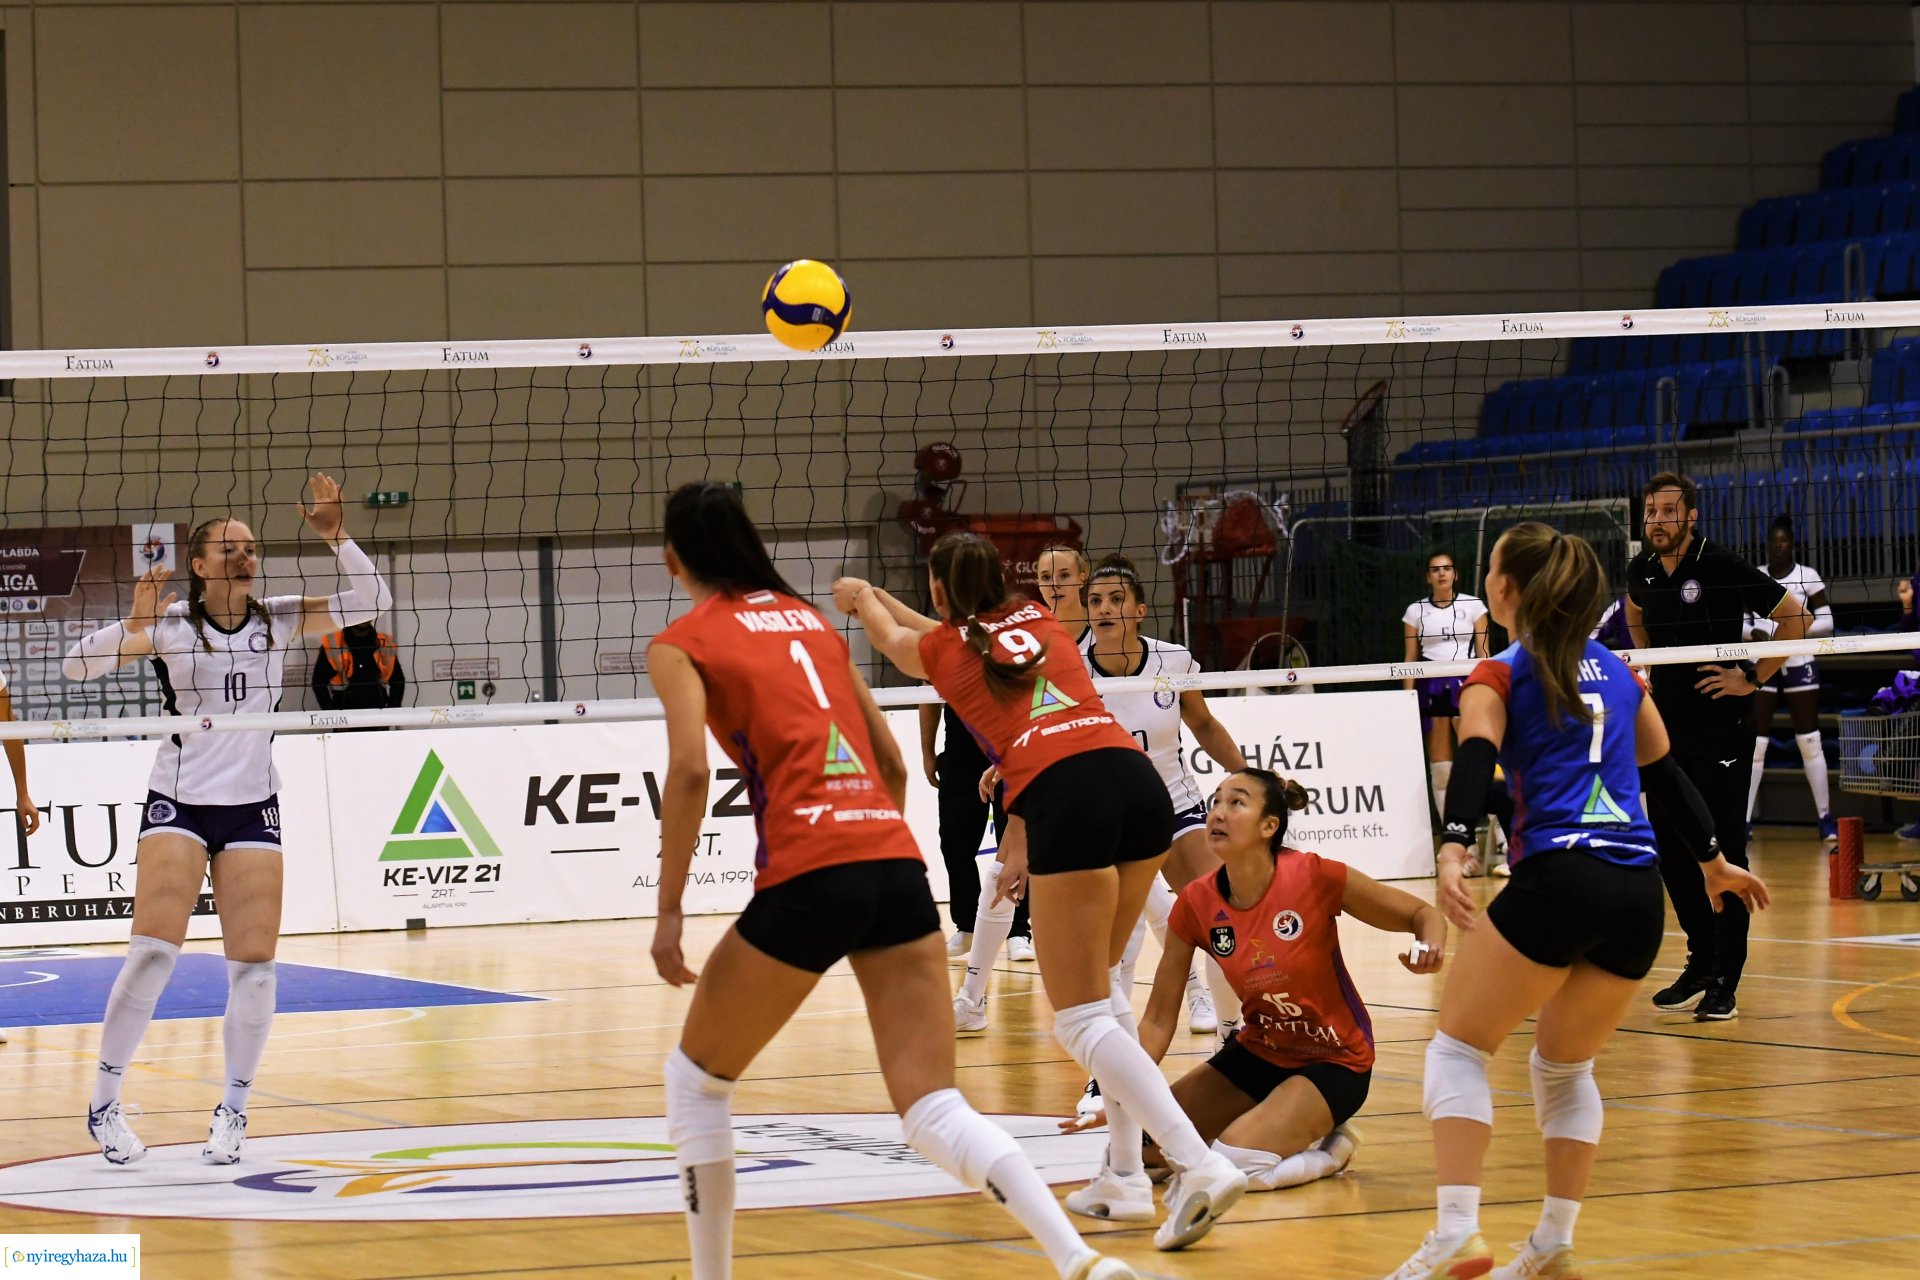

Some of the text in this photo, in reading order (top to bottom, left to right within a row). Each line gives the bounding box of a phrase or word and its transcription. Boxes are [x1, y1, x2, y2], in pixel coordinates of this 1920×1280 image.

[818, 342, 855, 353] ATUM
[0, 574, 38, 591] IGA
[998, 629, 1046, 665] 9
[789, 640, 831, 709] 1
[225, 672, 247, 702] 10
[1579, 693, 1605, 763] 7
[1190, 736, 1324, 775] GHÁZI
[261, 807, 279, 827] 10
[1287, 824, 1389, 844] Nonprofit Kft.
[383, 863, 502, 887] KE-VIZ 21
[720, 870, 754, 885] 1991
[431, 888, 456, 899] ZRT.
